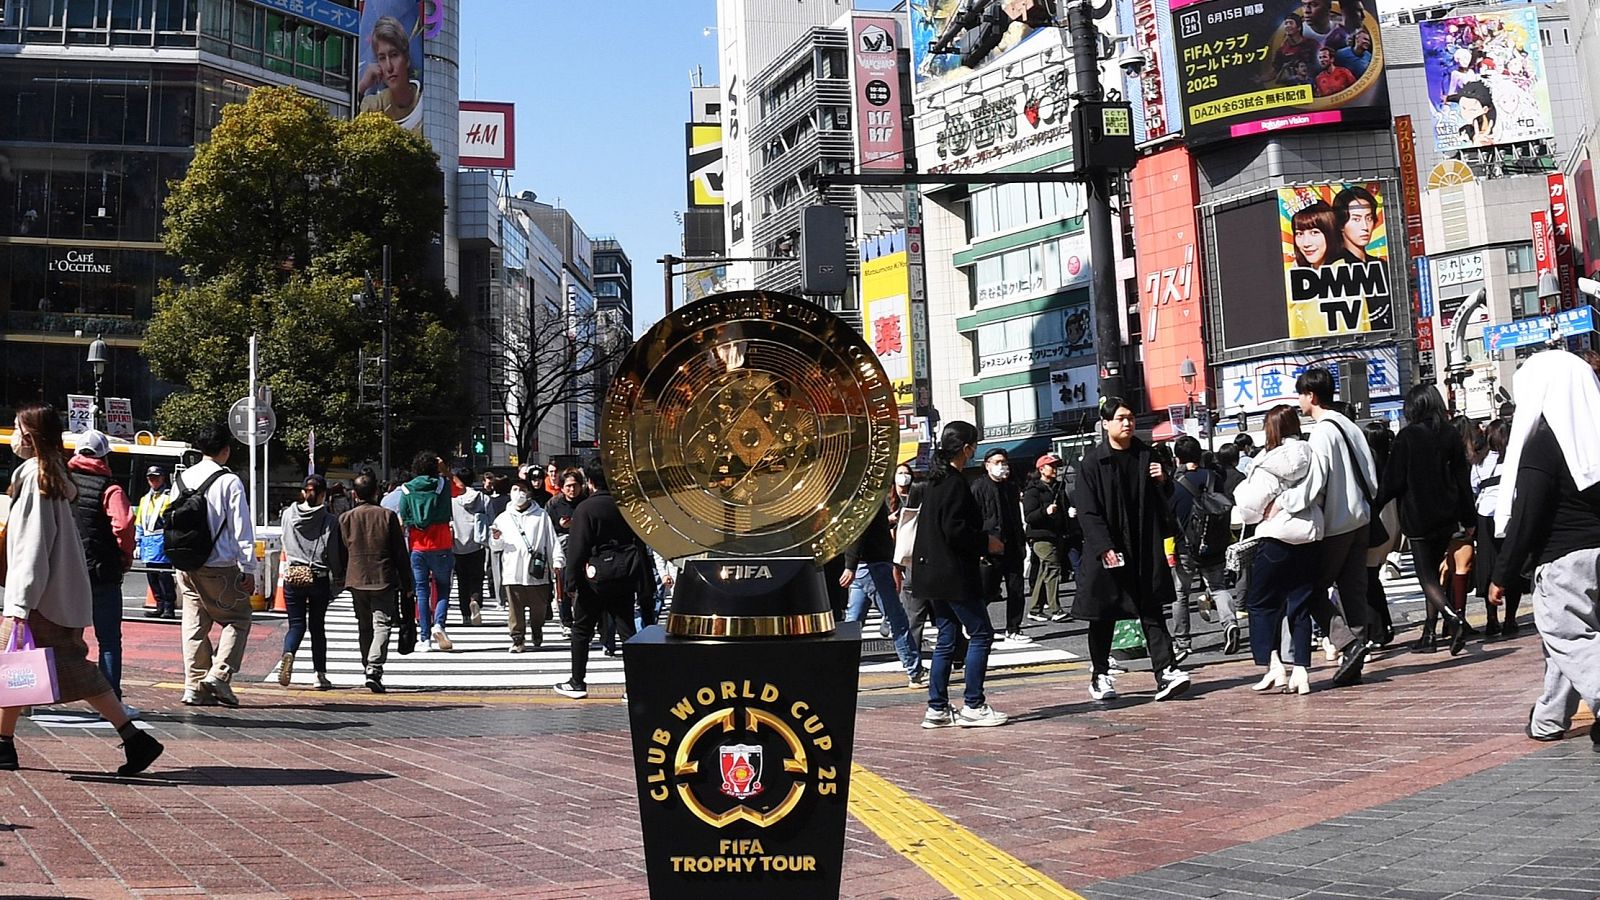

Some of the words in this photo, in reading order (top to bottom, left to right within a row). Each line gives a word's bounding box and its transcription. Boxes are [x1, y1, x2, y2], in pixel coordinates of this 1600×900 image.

[266, 0, 357, 27] 会話イーオン
[1207, 10, 1242, 25] 6月15日
[1244, 4, 1265, 18] 開幕
[1183, 47, 1212, 63] FIFA
[1213, 34, 1250, 53] クラブ
[1185, 45, 1270, 77] ワールドカップ
[1187, 74, 1218, 94] 2025
[1194, 103, 1222, 120] DAZN
[1222, 94, 1264, 113] 全63試合
[1265, 89, 1307, 105] 無料配信
[466, 123, 499, 146] H&M
[1261, 118, 1288, 130] Rakuten
[1289, 115, 1310, 127] Vision
[1549, 183, 1571, 256] カラオケ
[1449, 255, 1482, 269] れいわ
[1290, 261, 1388, 302] DMM
[1440, 268, 1483, 283] クリニック
[1320, 298, 1362, 332] TV
[1499, 309, 1589, 334] 火災予防運実施中
[874, 313, 903, 357] 薬
[720, 565, 774, 580] FIFA
[647, 727, 672, 802] CLUB
[670, 679, 780, 721] WORLD
[790, 700, 833, 751] CUP
[817, 765, 837, 796] 25
[719, 838, 765, 855] FIFA
[670, 856, 757, 873] TROPHY
[759, 855, 816, 872] TOUR
